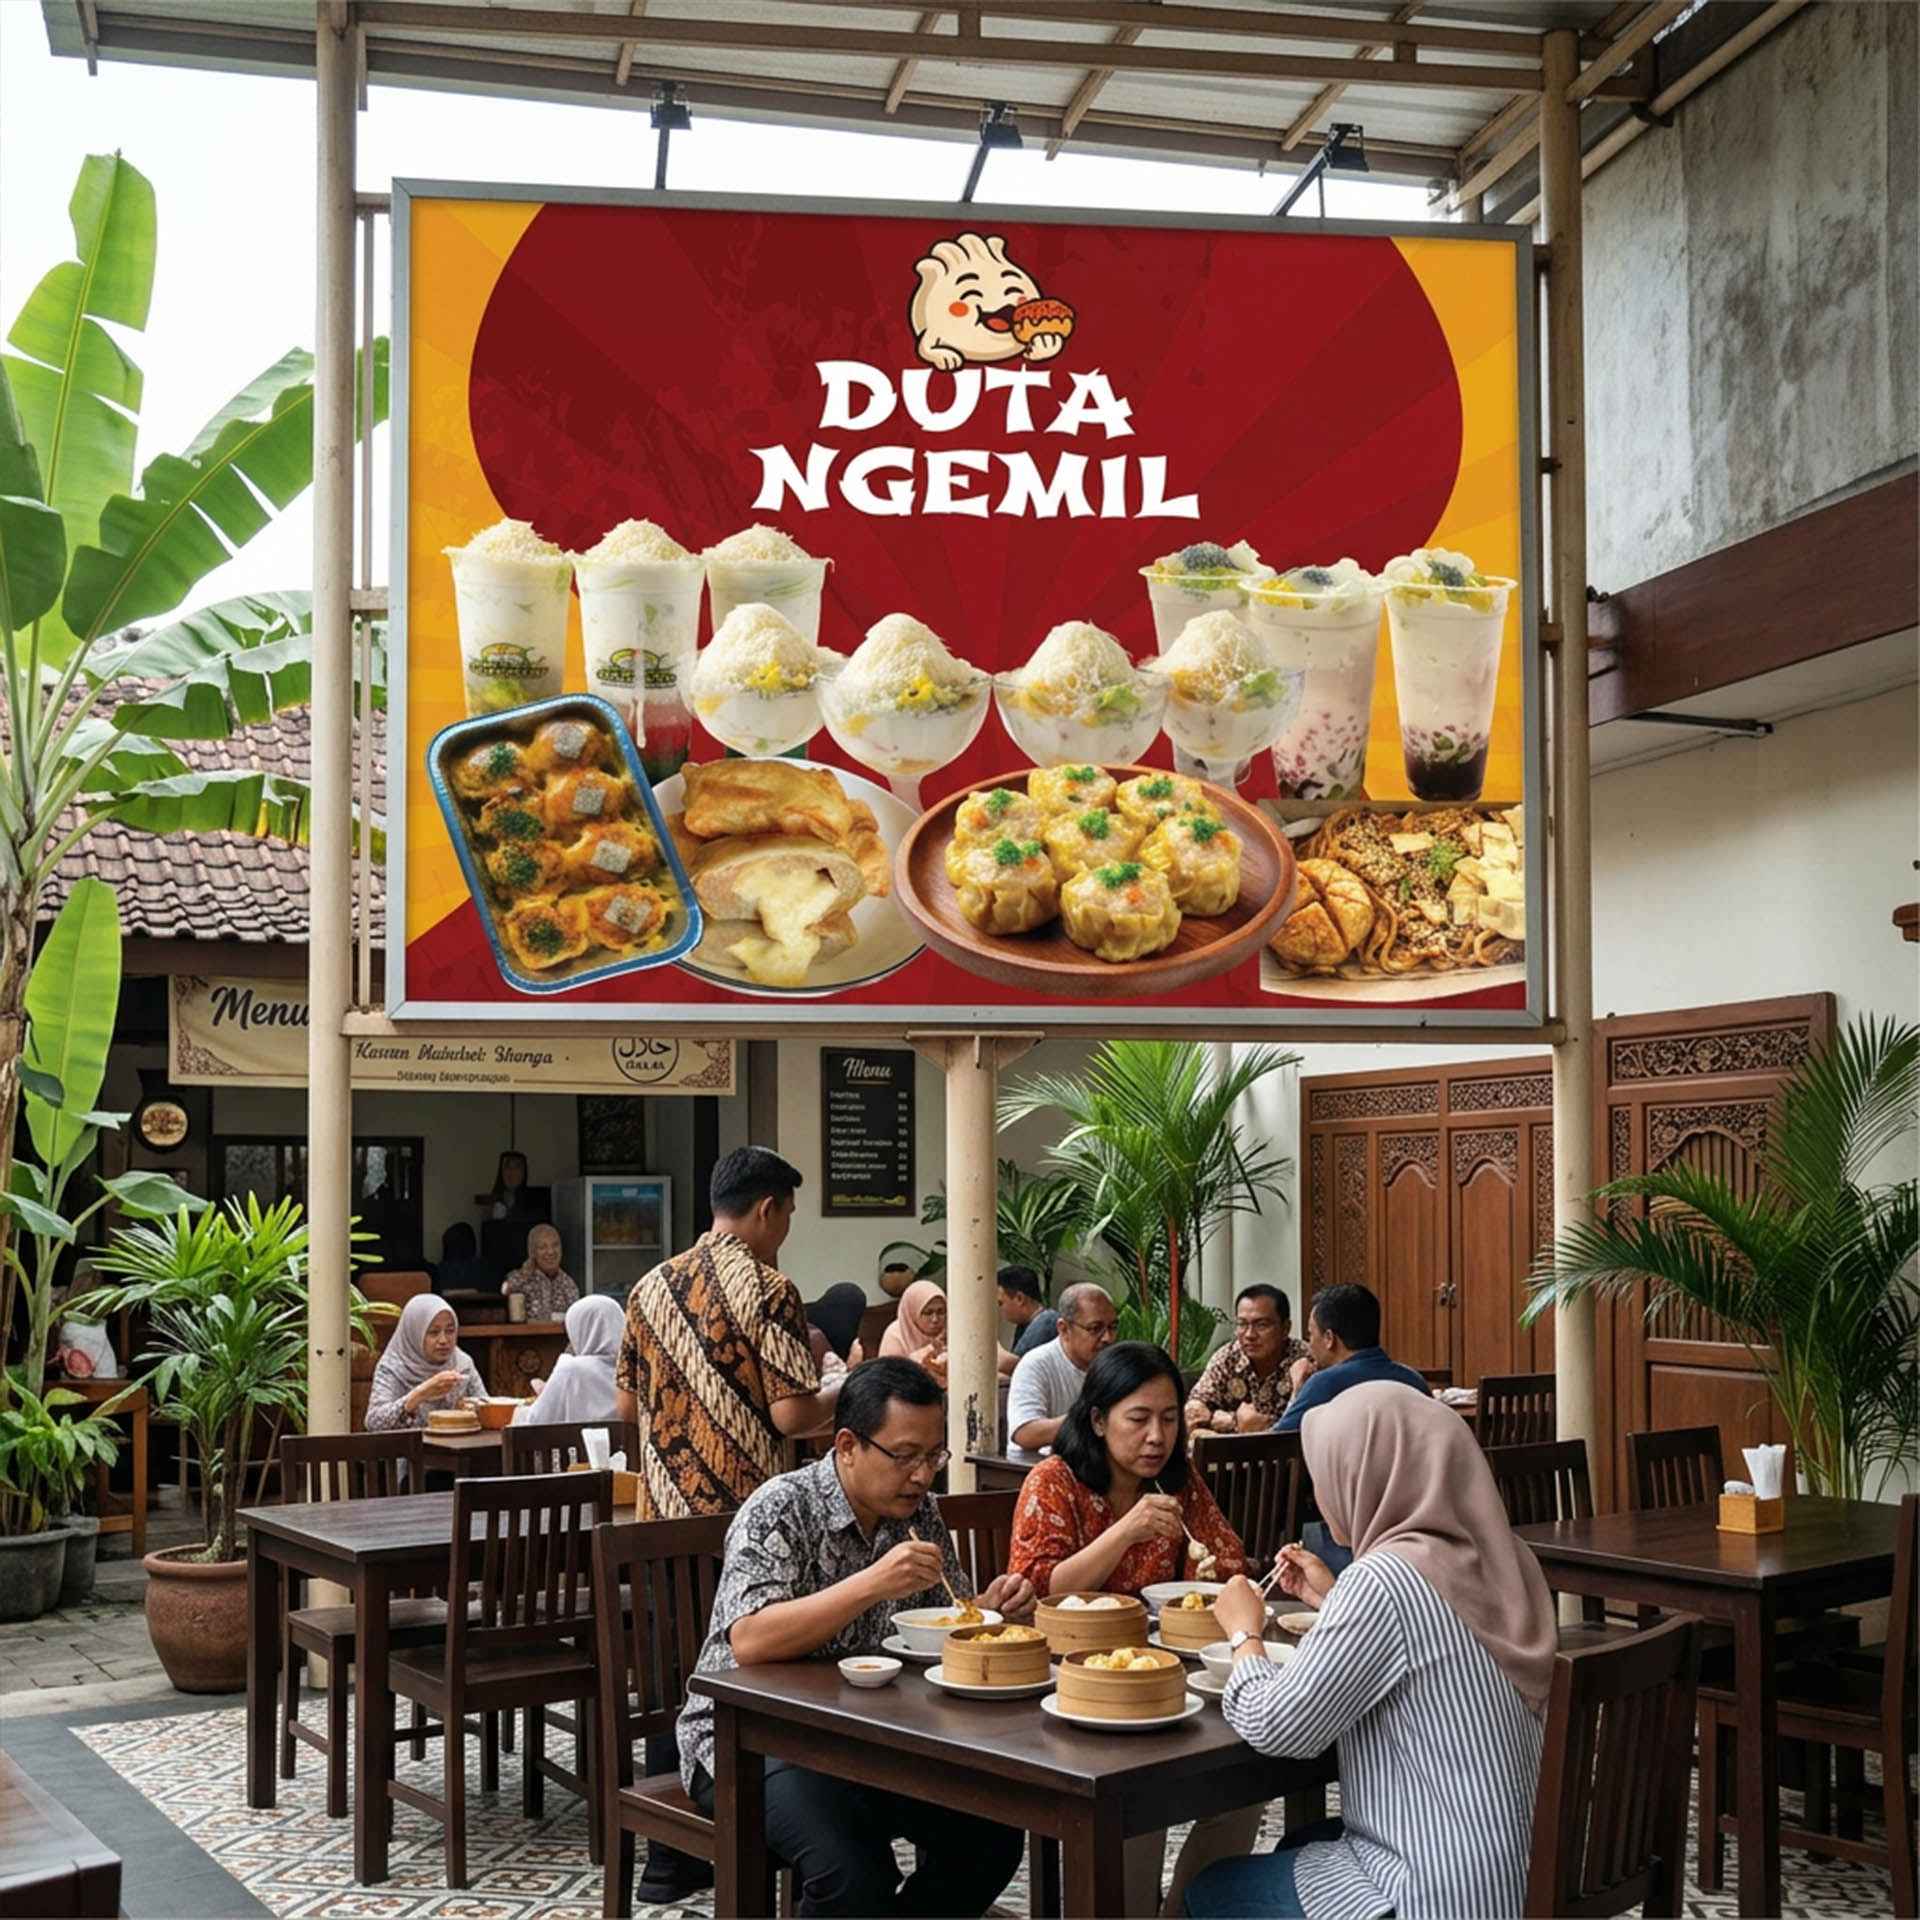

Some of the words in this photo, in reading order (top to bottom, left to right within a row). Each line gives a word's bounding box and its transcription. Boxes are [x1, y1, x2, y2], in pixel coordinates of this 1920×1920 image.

[815, 360, 1135, 440] DUTA
[748, 442, 1201, 520] NGEMIL
[210, 986, 310, 1031] Menu
